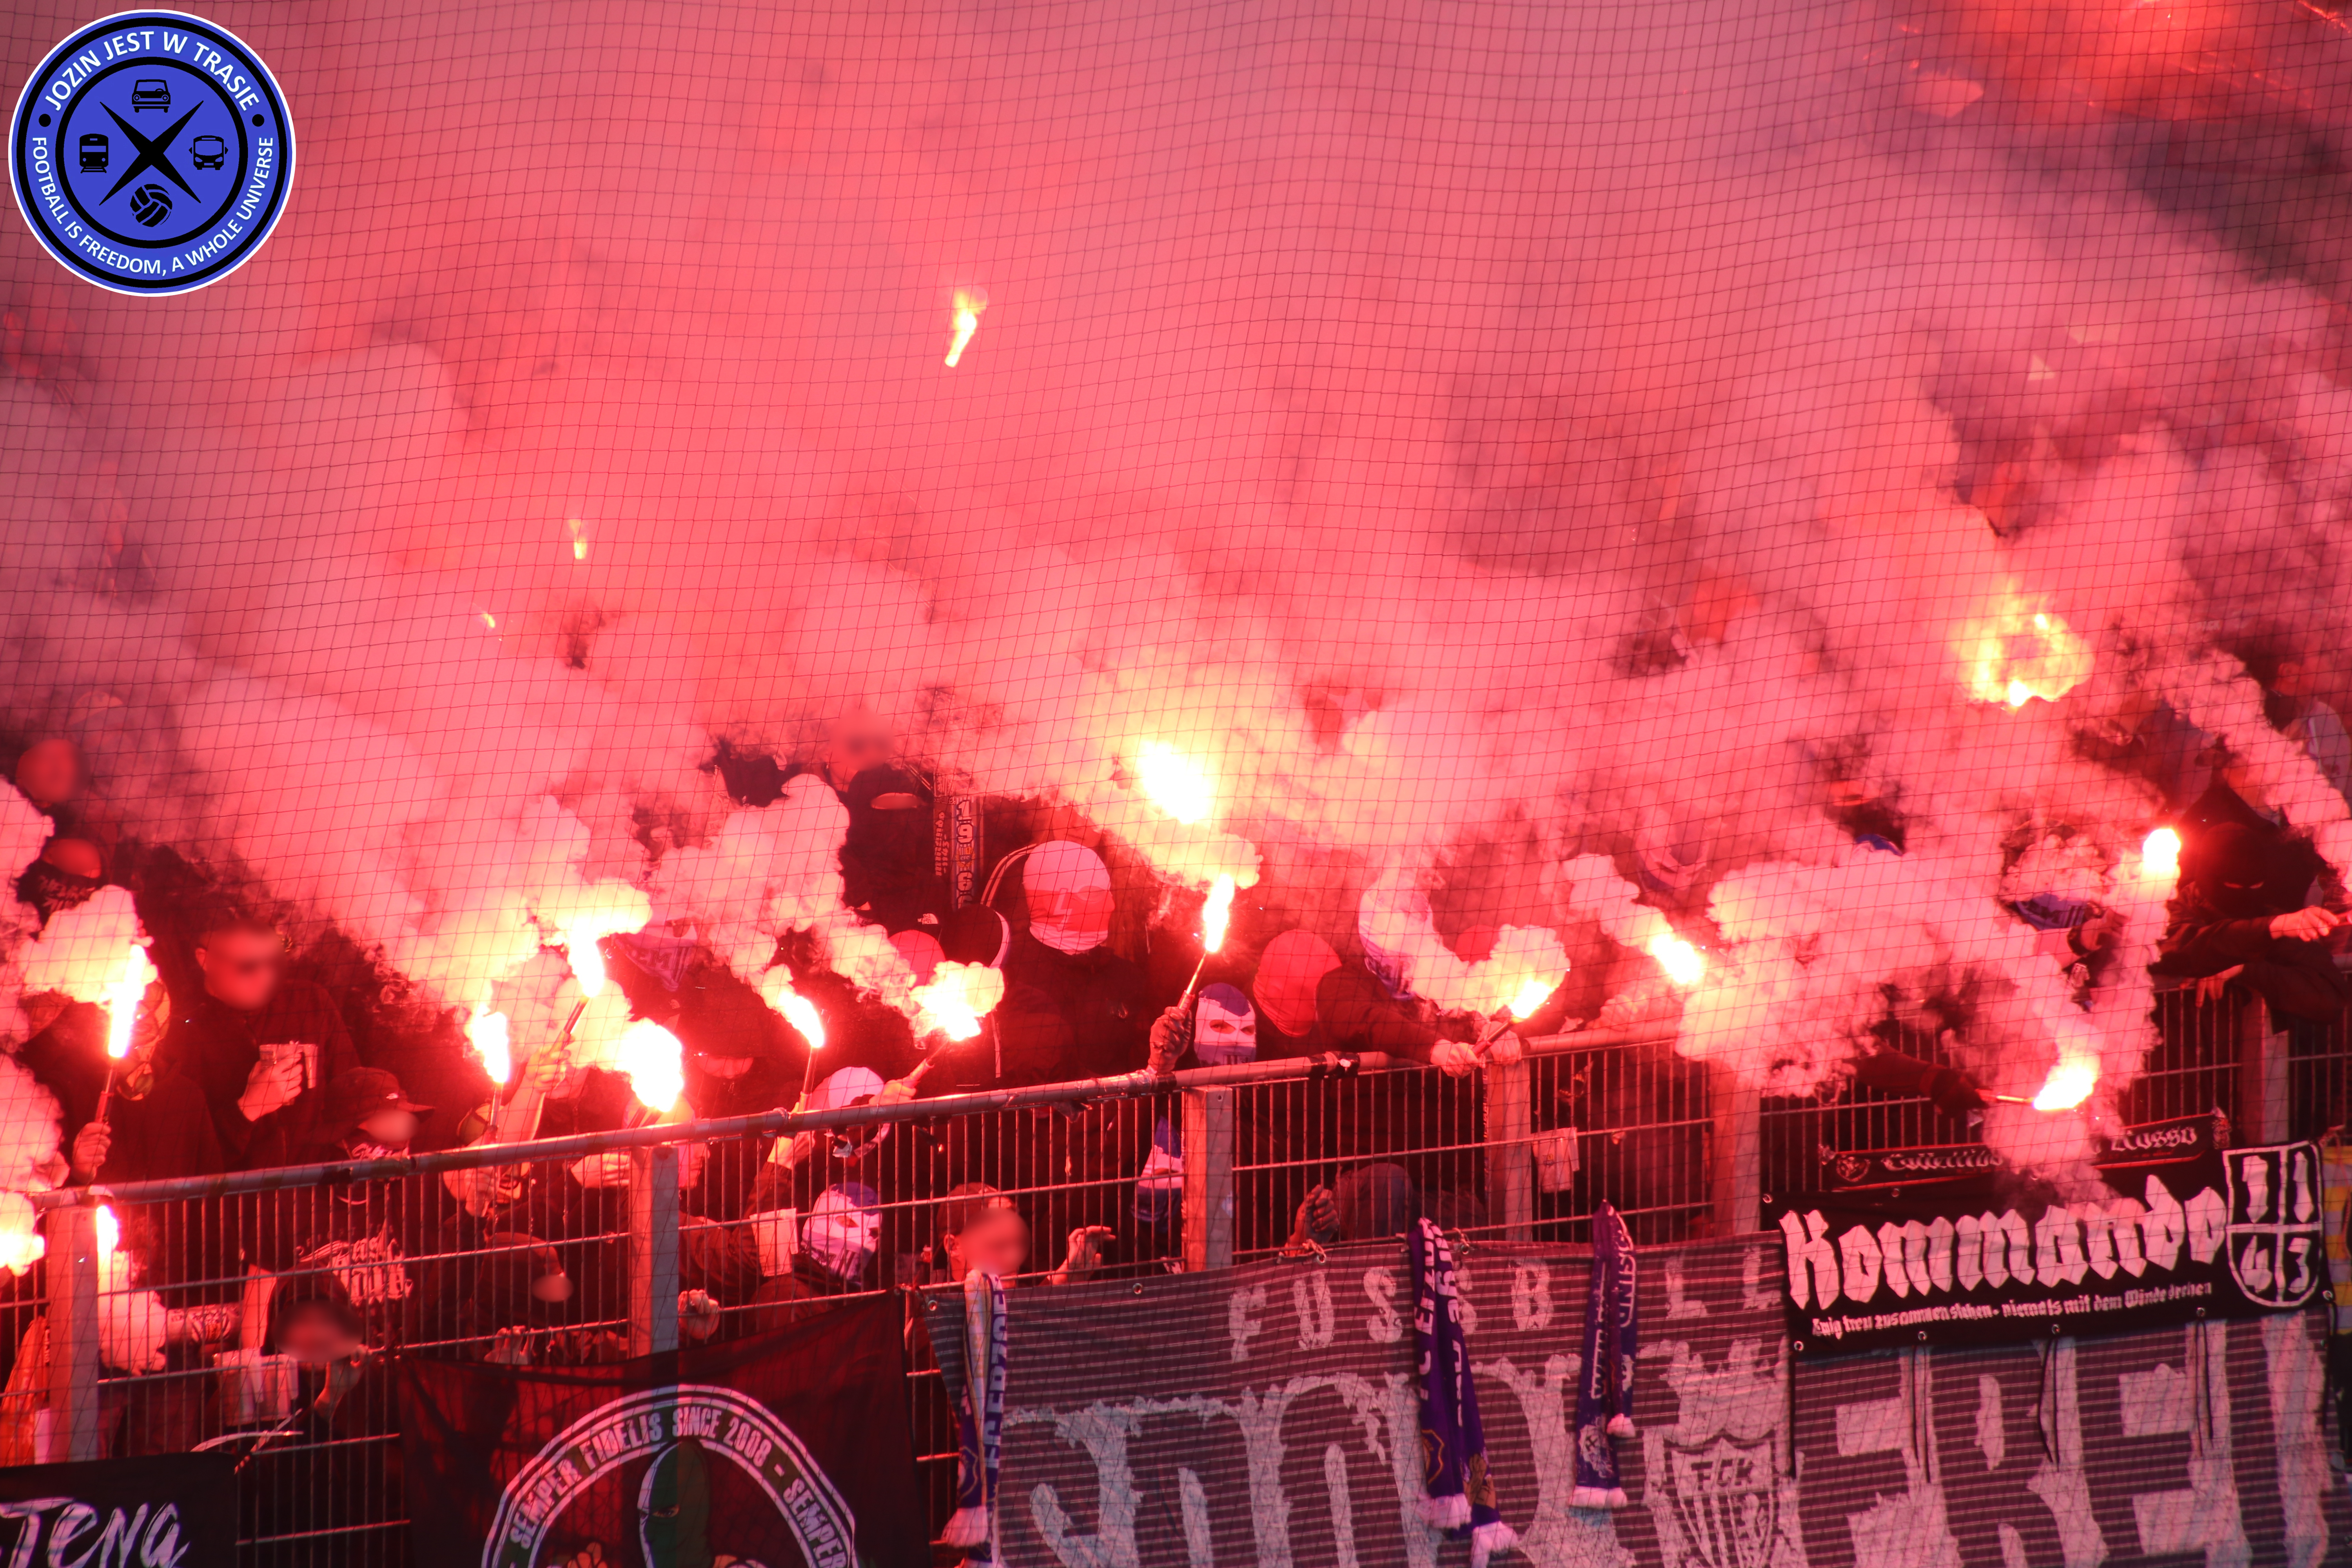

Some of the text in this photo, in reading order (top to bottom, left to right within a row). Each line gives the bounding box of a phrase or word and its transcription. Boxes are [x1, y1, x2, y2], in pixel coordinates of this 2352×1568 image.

[1779, 1174, 2226, 1309] Kommando
[1843, 1314, 1873, 1333] treu
[2063, 1294, 2091, 1314] mit
[510, 1457, 583, 1550] SEMPER
[578, 1411, 663, 1470] FIDELIS
[671, 1406, 722, 1439] SINCE
[723, 1416, 773, 1468] 2008
[783, 1478, 847, 1568] SEMPER
